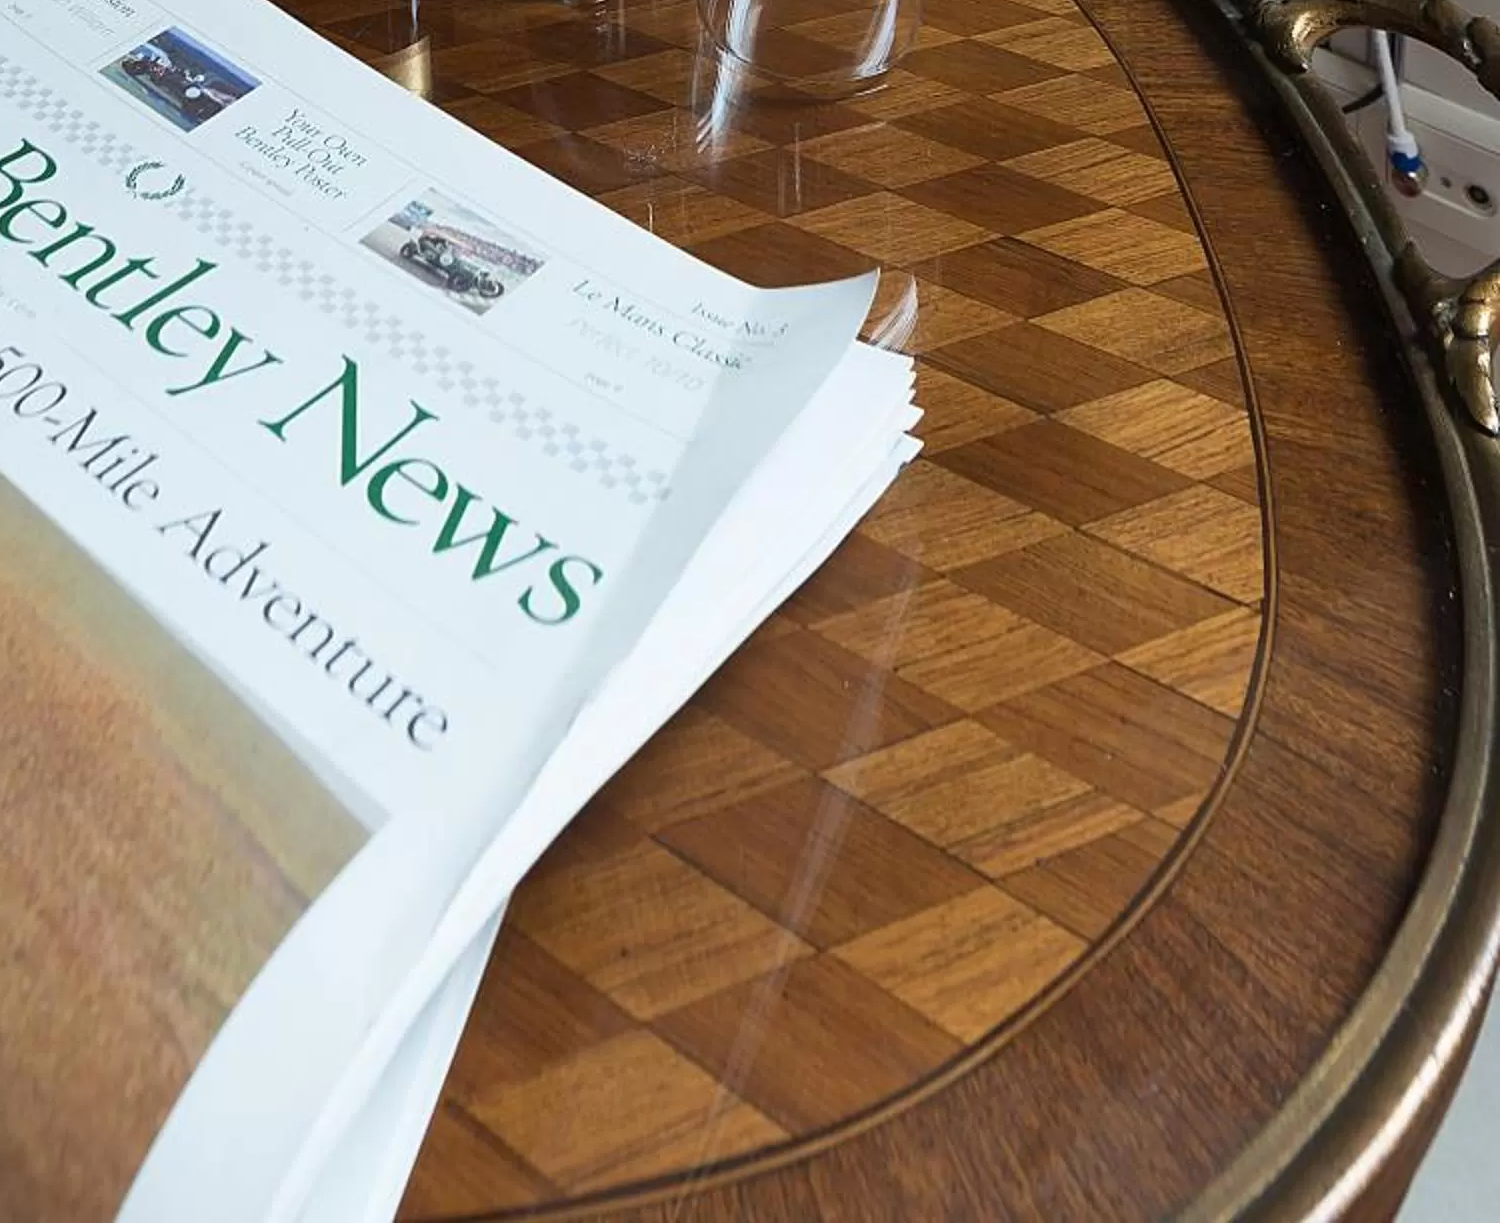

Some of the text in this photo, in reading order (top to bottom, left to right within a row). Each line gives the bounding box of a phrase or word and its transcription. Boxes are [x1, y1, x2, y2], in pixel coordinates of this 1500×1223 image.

[235, 125, 297, 169] Bentley
[295, 161, 348, 201] Poster
[282, 107, 371, 168] Your Own
[572, 279, 602, 301] Le
[603, 296, 664, 337] Mans
[257, 353, 604, 626] News
[156, 507, 450, 751] Adventure
